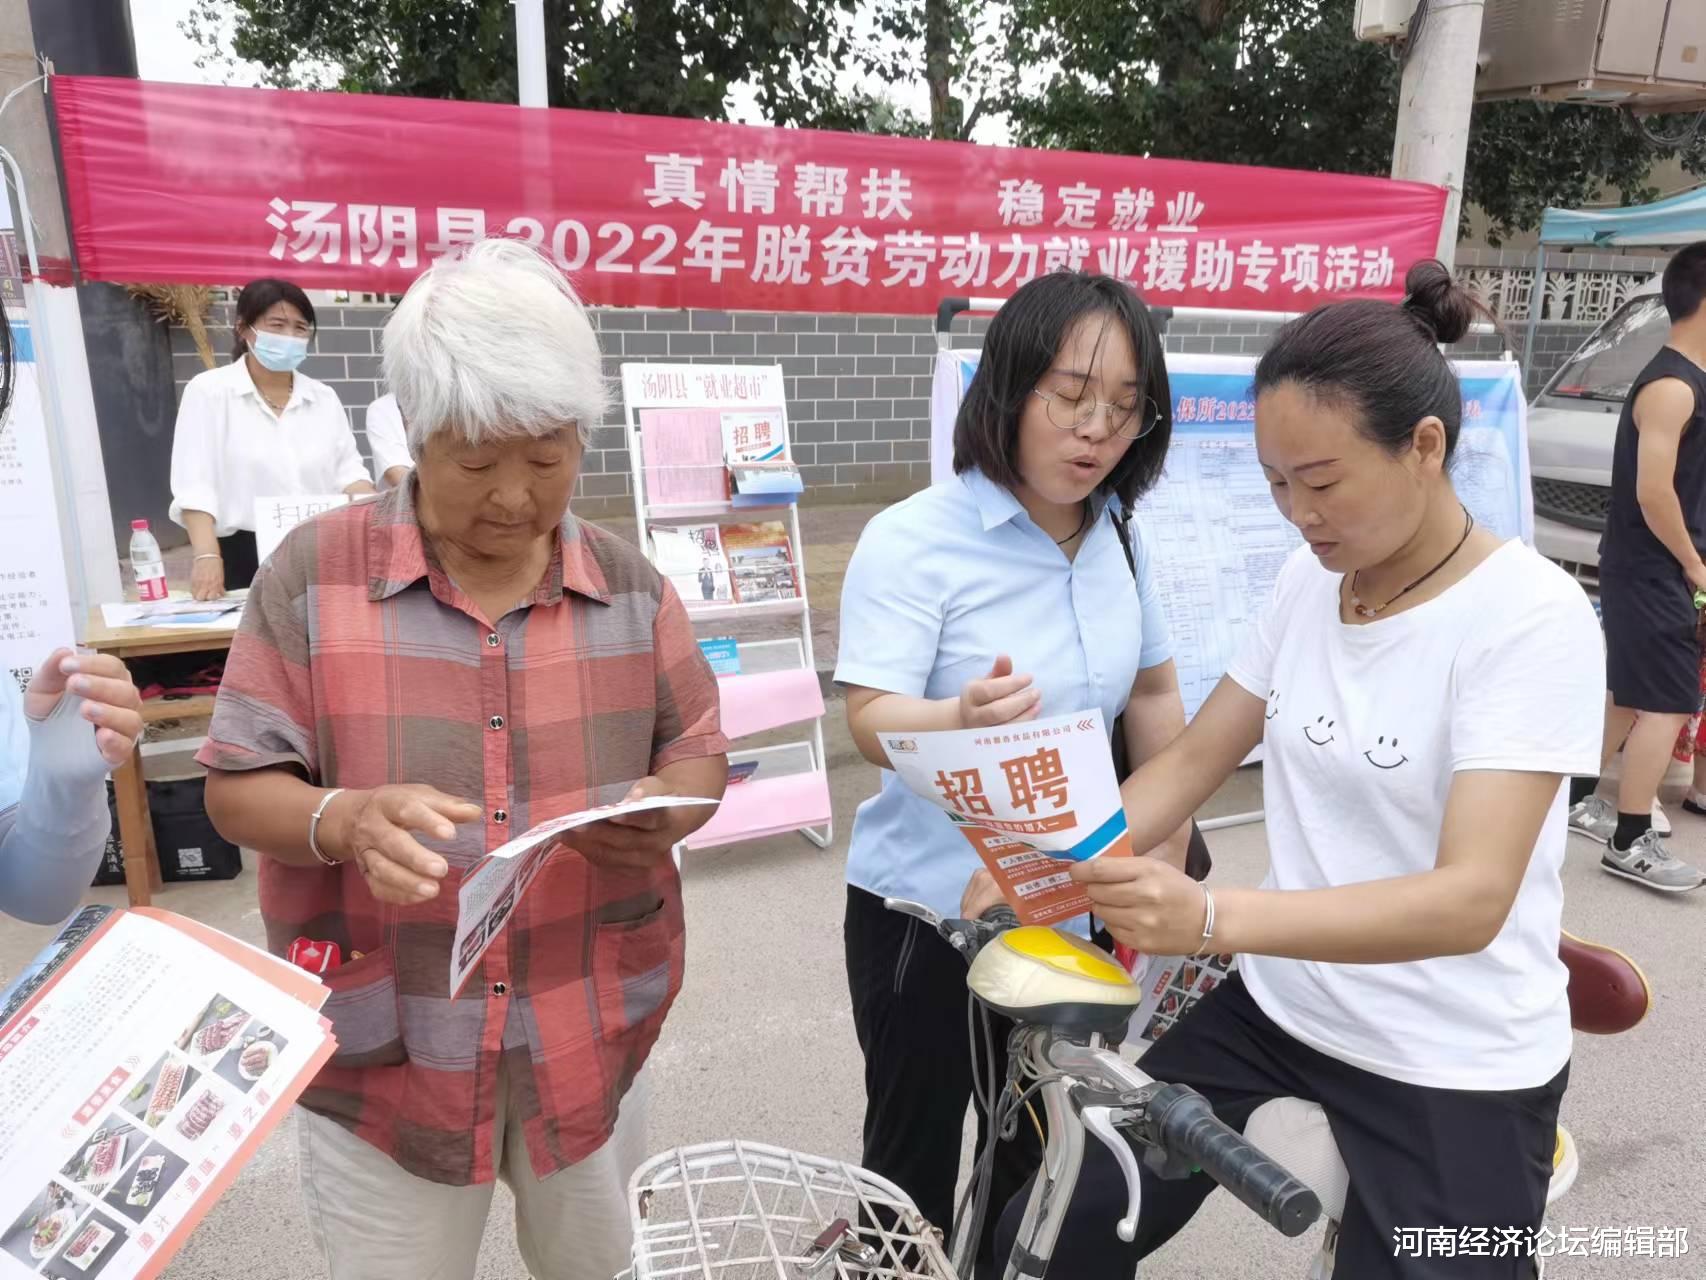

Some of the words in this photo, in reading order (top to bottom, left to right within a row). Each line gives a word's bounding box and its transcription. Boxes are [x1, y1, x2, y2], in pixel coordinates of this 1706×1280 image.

[644, 153, 913, 222] 真情帮扶
[998, 177, 1206, 234] 稳定就业
[265, 196, 1395, 294] 汤阴县2022年脱贫劳动力就业援助专项活动
[933, 746, 1069, 817] 招聘
